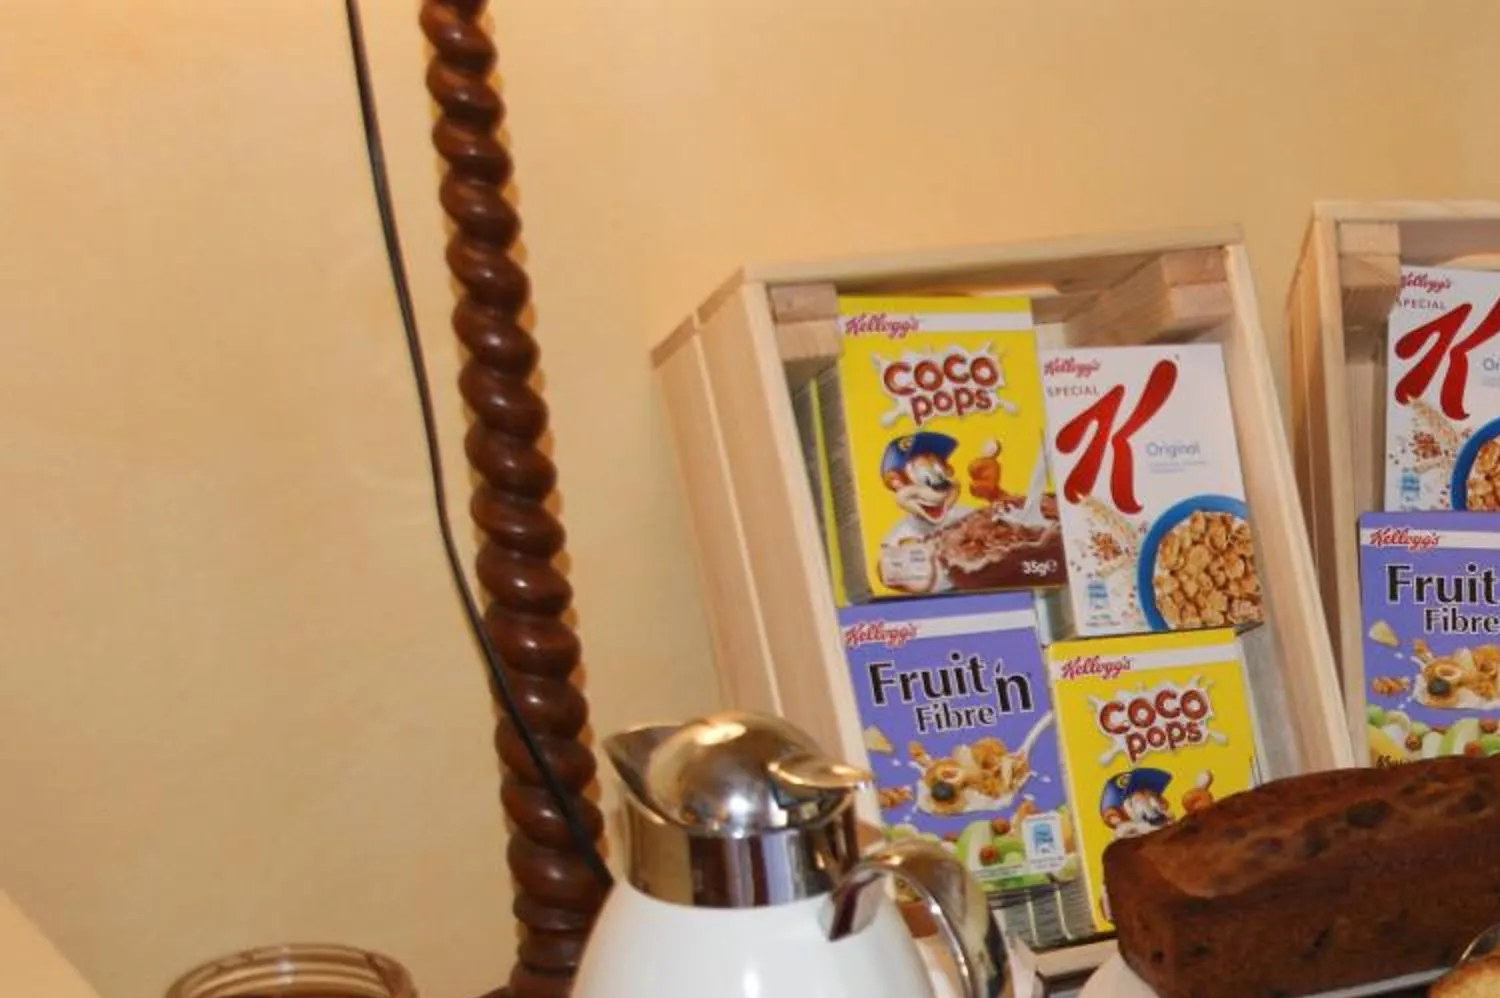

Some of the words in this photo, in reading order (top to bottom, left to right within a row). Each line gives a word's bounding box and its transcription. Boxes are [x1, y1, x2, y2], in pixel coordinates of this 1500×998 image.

[846, 314, 920, 338] Kellogg's
[883, 354, 999, 396] COCO
[1044, 357, 1101, 378] Kellogg's
[1046, 385, 1099, 397] SPECIAL
[1056, 359, 1178, 514] K
[1146, 440, 1200, 458] Original
[1370, 527, 1440, 550] Kellogg's
[1386, 563, 1498, 604] Fruit
[1425, 608, 1499, 633] Fibre
[844, 622, 917, 648] Kellogg's
[869, 652, 988, 706] Fruit
[1061, 657, 1133, 680] Kellogg's
[917, 705, 995, 733] Fibre
[1100, 688, 1208, 734] COCO
